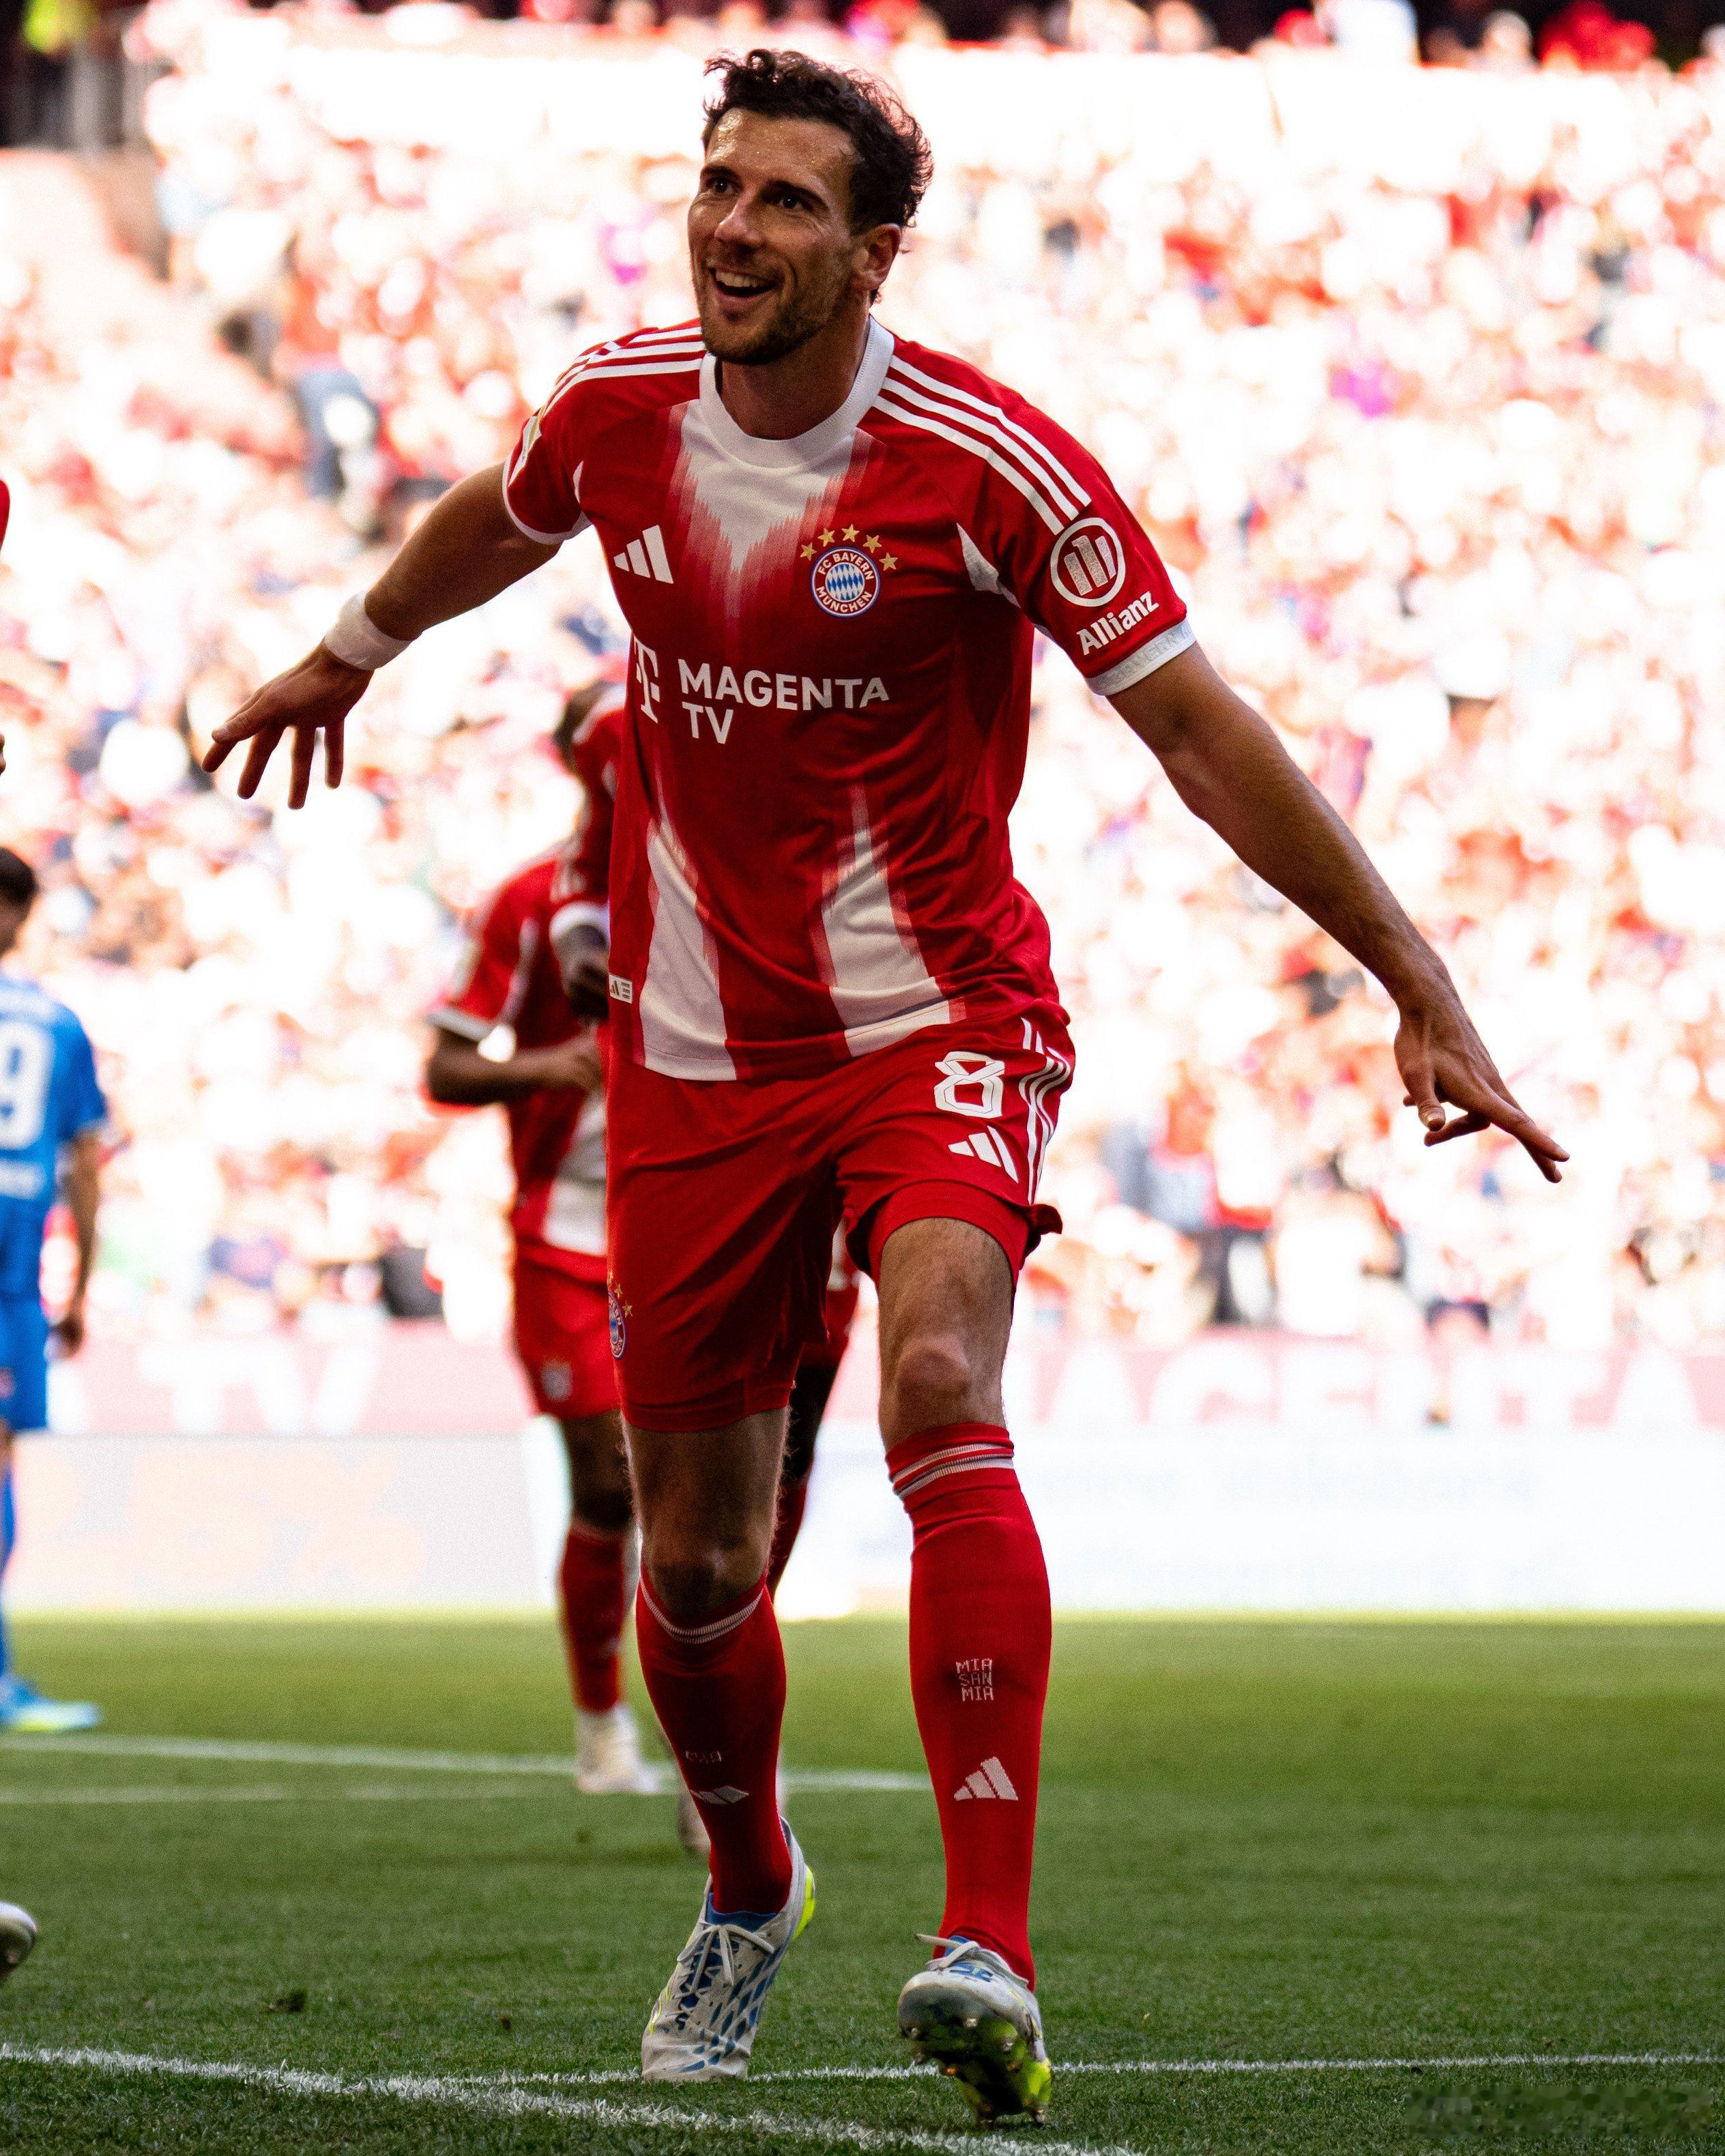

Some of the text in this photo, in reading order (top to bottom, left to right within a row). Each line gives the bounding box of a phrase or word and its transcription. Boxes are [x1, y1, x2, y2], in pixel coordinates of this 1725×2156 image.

[819, 552, 874, 580] FC BAYERN
[1076, 590, 1159, 656] Allianz
[678, 659, 889, 711] MAGENTA
[682, 701, 734, 744] TV
[933, 1051, 1005, 1119] 8
[956, 1659, 992, 1673] MIA
[959, 1672, 992, 1686] SAN
[961, 1687, 994, 1702] MIA
